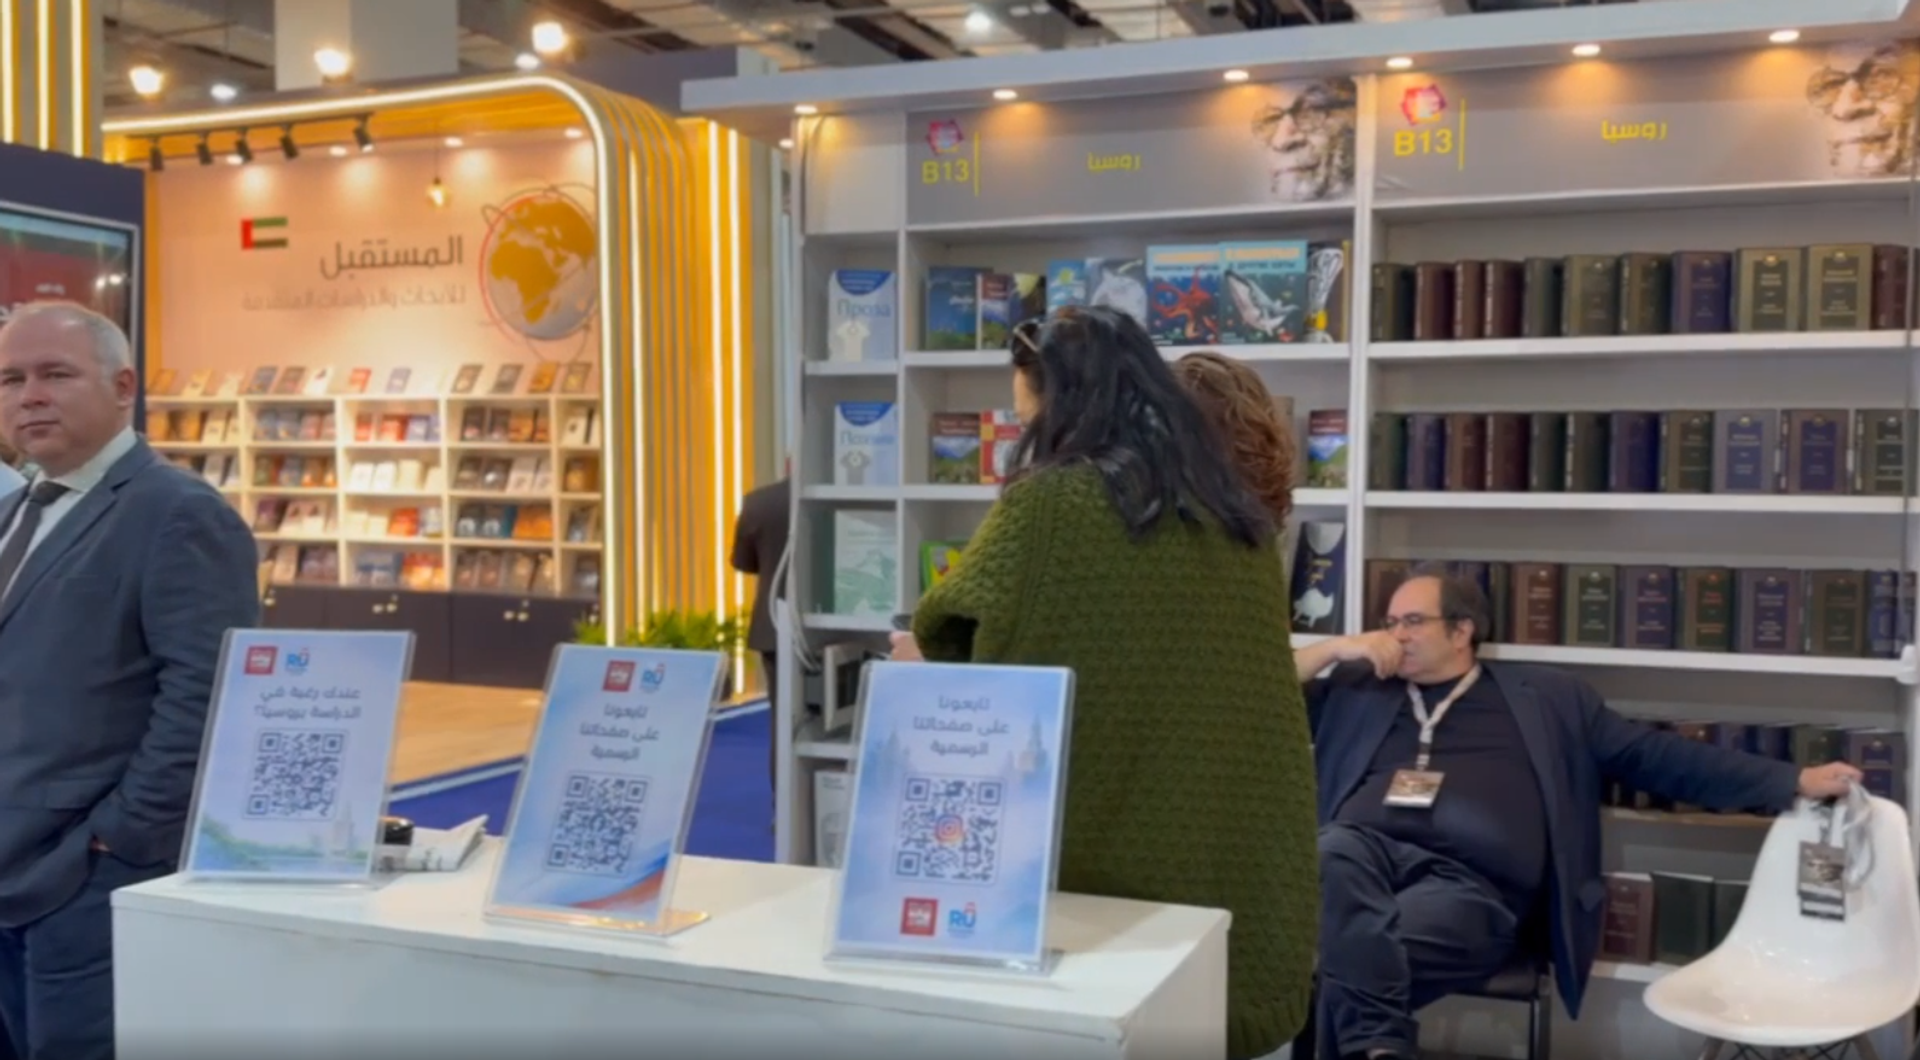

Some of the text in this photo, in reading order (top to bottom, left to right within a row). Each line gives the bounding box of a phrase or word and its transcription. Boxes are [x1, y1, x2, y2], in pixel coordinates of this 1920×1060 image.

[1601, 120, 1667, 144] روسيا
[1393, 129, 1452, 156] B13
[922, 158, 969, 184] B13
[1087, 152, 1141, 172] روسيا
[320, 235, 463, 280] المستقبل
[261, 687, 285, 701] في
[324, 687, 360, 698] عندك
[605, 704, 647, 718] تابعونا
[939, 696, 989, 711] تابعونا
[633, 728, 658, 741] على
[914, 716, 1009, 736] على صفحاتنا
[931, 740, 988, 757] الرسمية
[949, 905, 976, 927] RU
